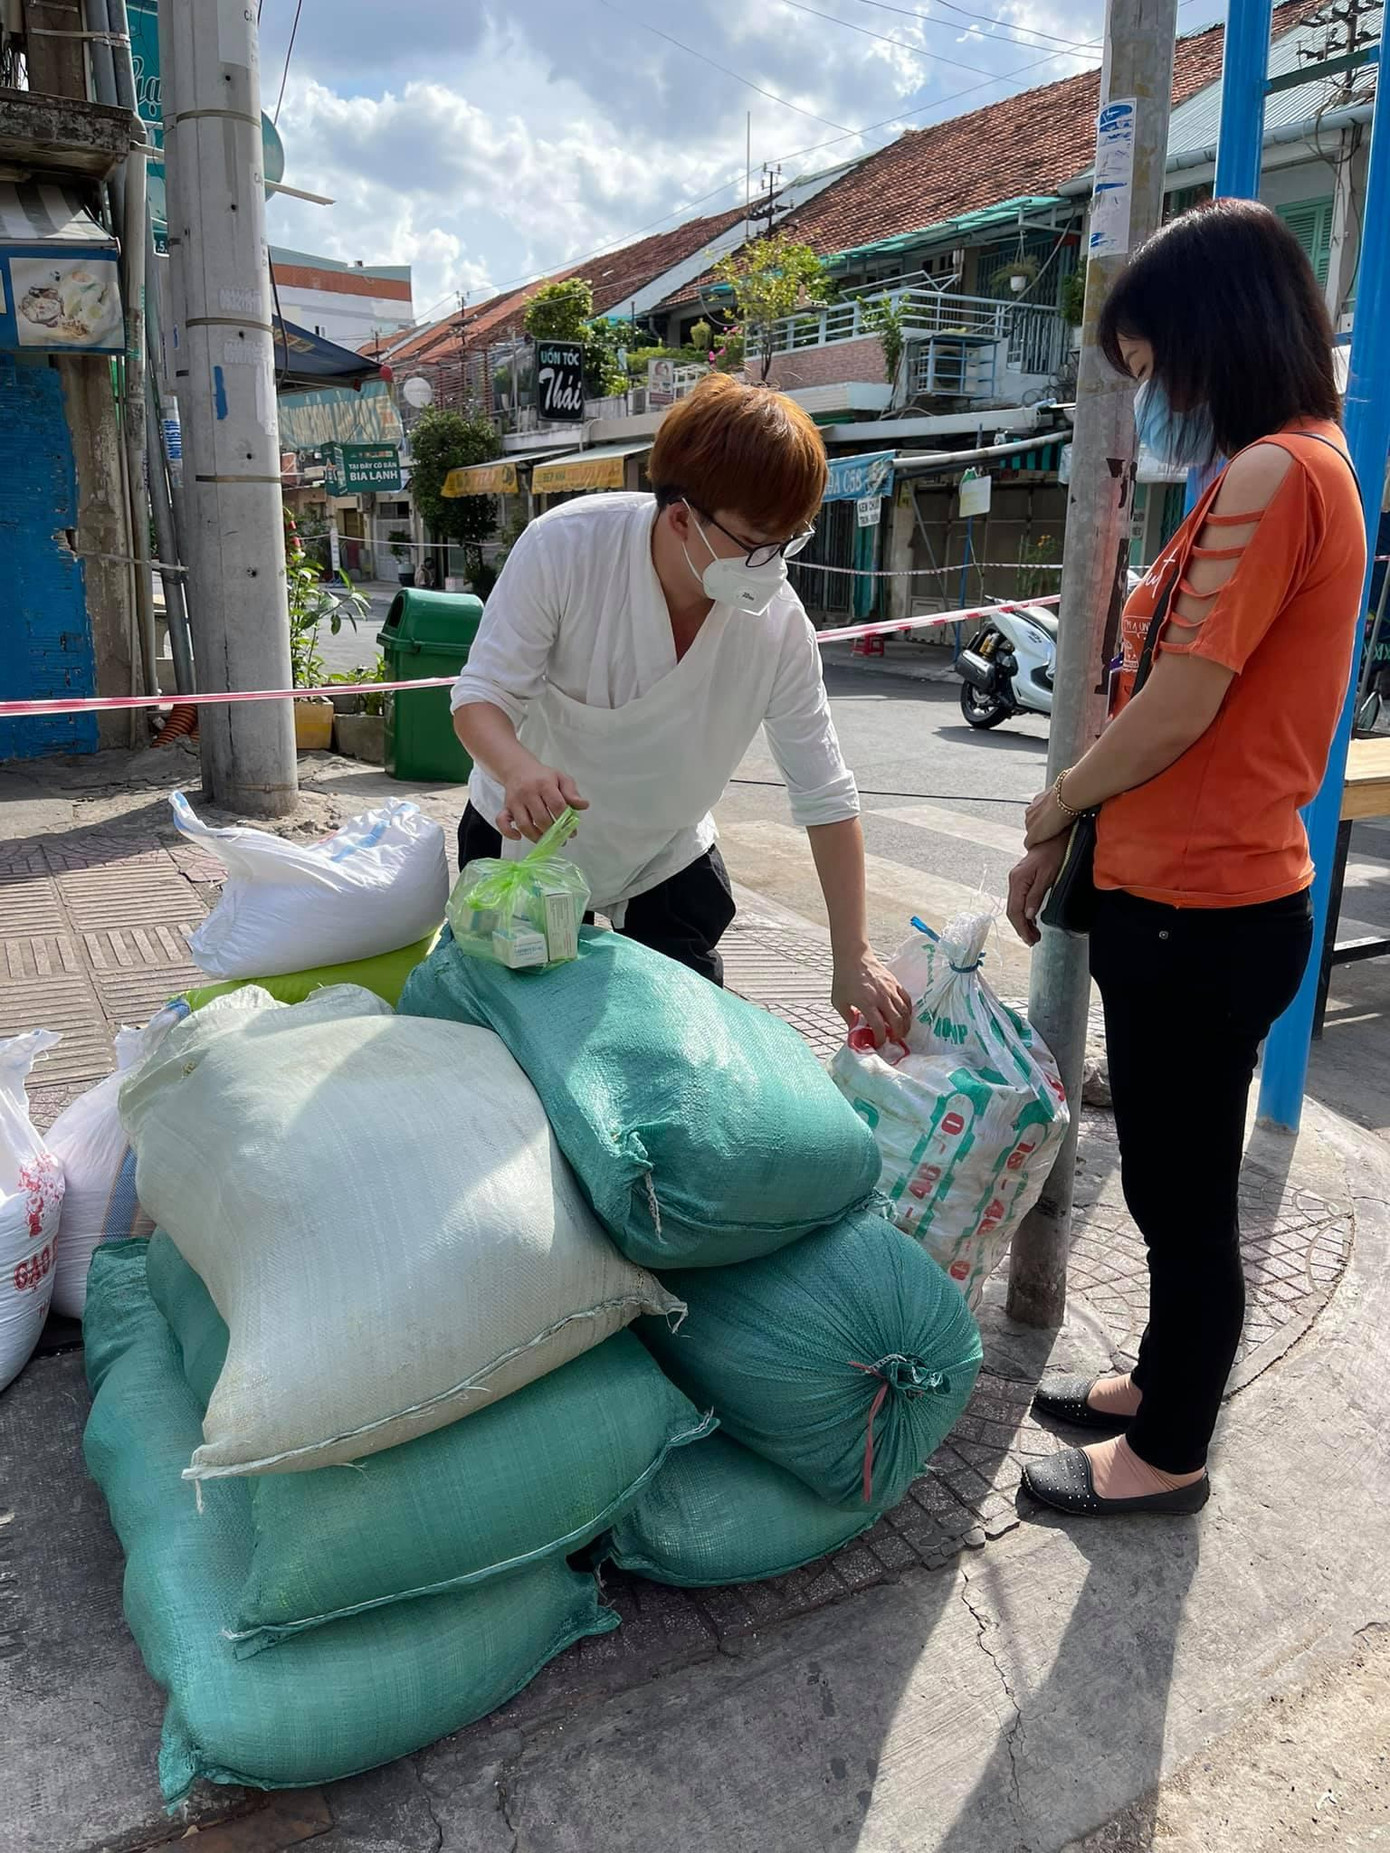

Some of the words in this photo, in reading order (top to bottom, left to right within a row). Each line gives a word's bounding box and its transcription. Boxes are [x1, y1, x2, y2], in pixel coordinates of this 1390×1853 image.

[562, 348, 580, 366] TÓC
[538, 367, 582, 411] Thái
[349, 471, 368, 482] BIA
[369, 469, 399, 483] LẠNH
